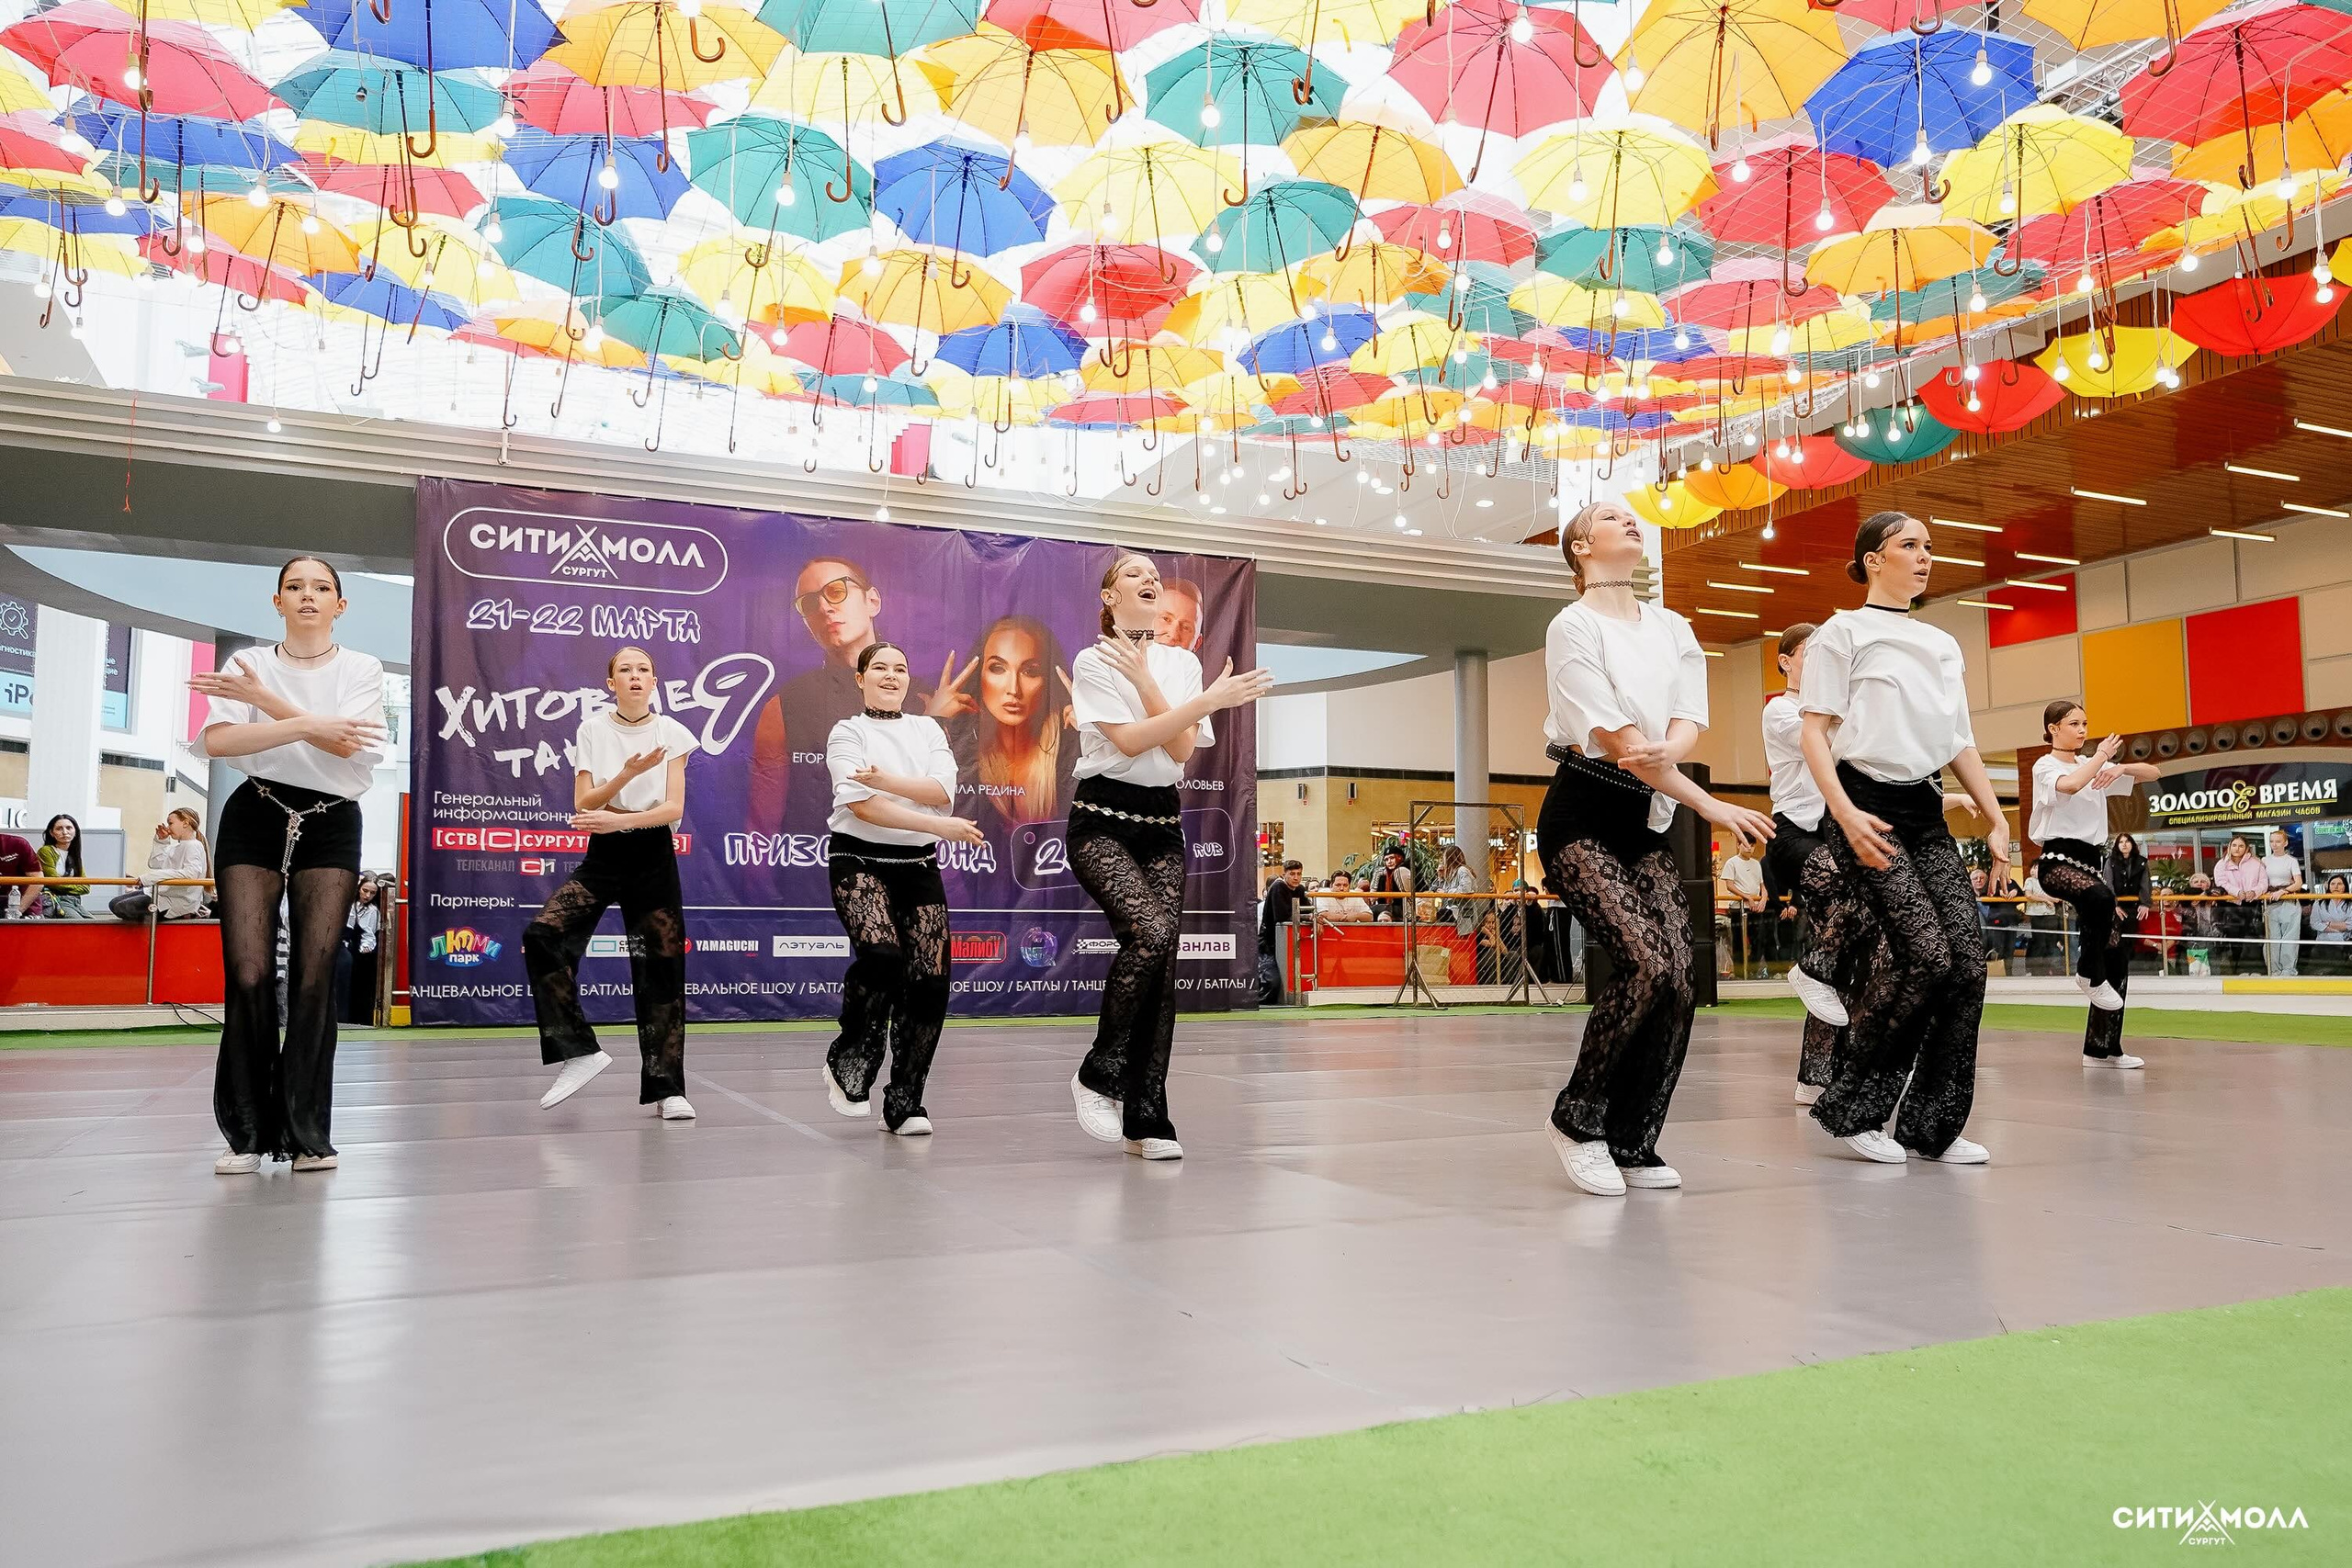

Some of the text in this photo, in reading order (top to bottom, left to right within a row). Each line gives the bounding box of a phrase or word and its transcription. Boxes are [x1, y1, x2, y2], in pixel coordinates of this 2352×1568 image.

[561, 565, 608, 579] СУРГУТ
[467, 597, 701, 644] 21-22 МАРТА
[793, 751, 825, 764] ЕГОР
[978, 784, 1026, 797] РЕДИНА
[1176, 779, 1225, 792] ОЛОВЬЕВ
[2259, 778, 2338, 805] ВРЕМЯ
[433, 791, 542, 807] Генеральный
[2168, 807, 2321, 826] СПЕЦИАЛИЗИРОВАННЫЙ МАГАЗИН ЧАСОВ
[1193, 841, 1224, 857] RUB
[935, 838, 997, 874] ОНД
[457, 859, 515, 872] ТЕЛЕКАНАЛ
[430, 894, 514, 909] Партнеры:
[695, 940, 759, 952] YAMAGUCHI
[448, 953, 480, 964] парк
[684, 983, 758, 995] ЕВАЛЬНОЕ
[761, 982, 796, 995] ШОУ
[973, 980, 1005, 993] ШОУ
[1174, 978, 1194, 990] ОУ
[410, 984, 523, 998] АНЦЕВАЛЬНОЕ
